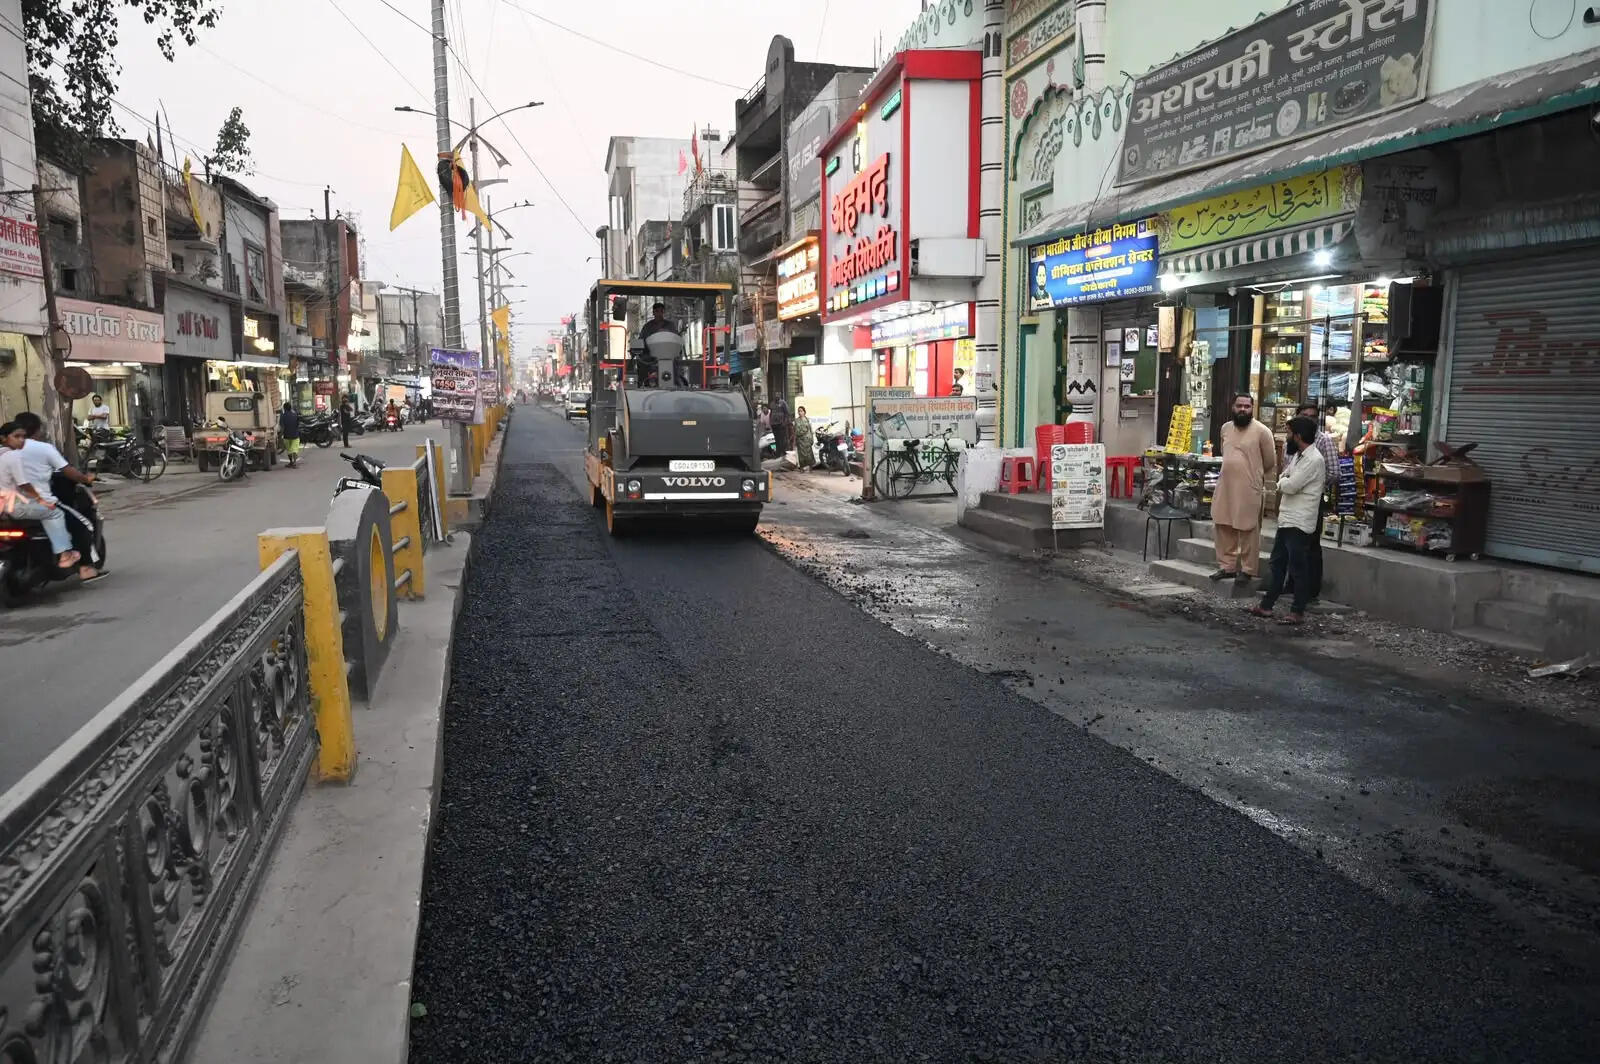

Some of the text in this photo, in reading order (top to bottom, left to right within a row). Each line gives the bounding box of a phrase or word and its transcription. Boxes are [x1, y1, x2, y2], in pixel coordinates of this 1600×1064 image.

[1130, 38, 1276, 124] अशरफी
[830, 152, 889, 236] अहमद
[1047, 237, 1071, 257] भारतीय
[1071, 233, 1093, 252] जीवन
[1094, 228, 1112, 247] बीमा
[1113, 223, 1137, 242] निगम
[61, 306, 121, 338] सार्थक
[662, 477, 726, 487] VOLVO
